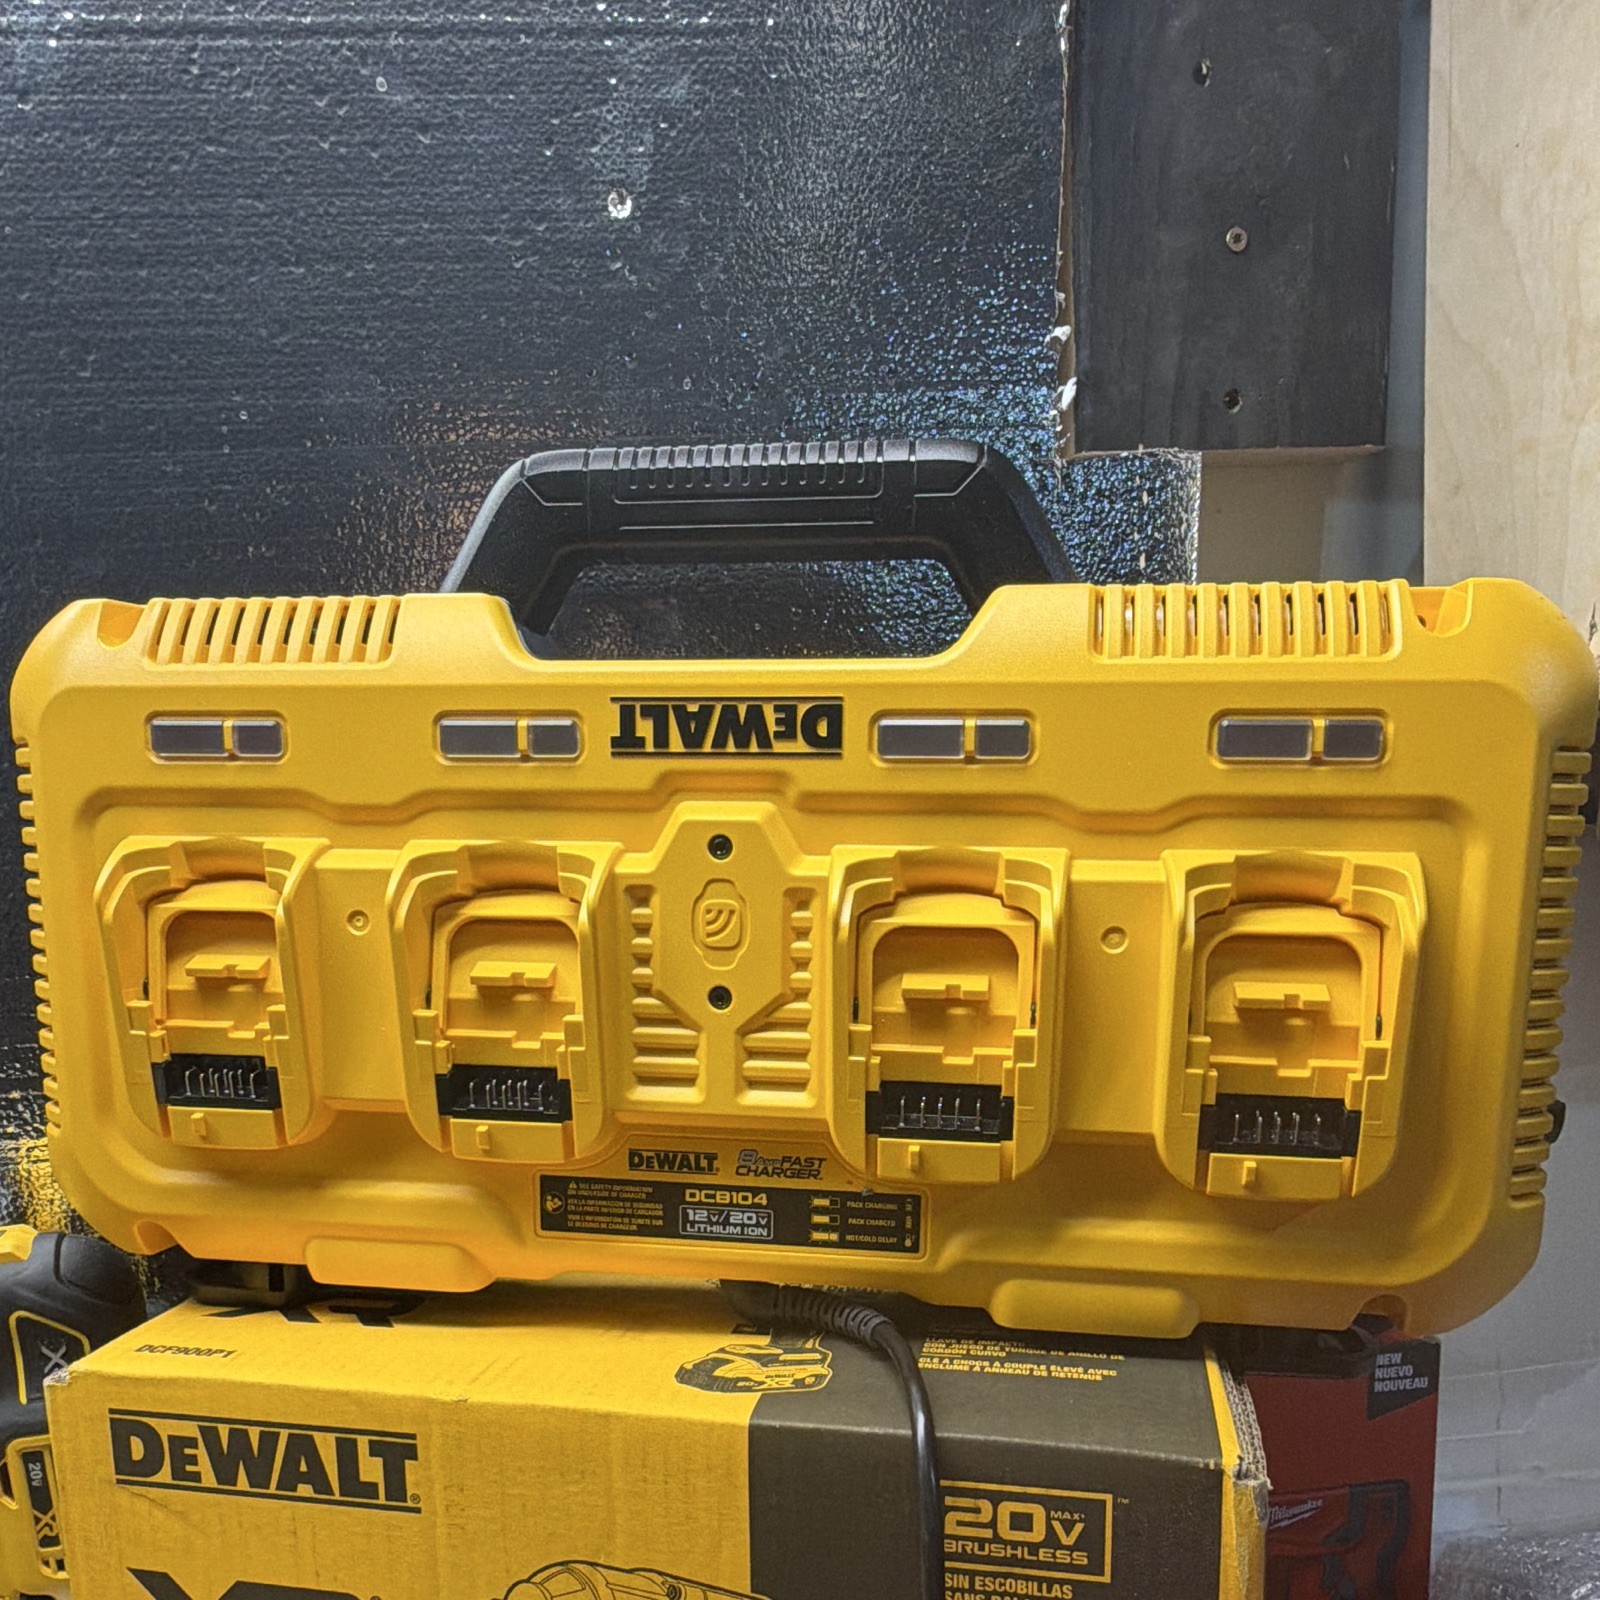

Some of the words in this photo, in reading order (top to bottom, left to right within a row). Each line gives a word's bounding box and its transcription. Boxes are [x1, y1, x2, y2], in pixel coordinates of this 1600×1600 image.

[610, 703, 843, 750] DEWALT
[628, 1151, 719, 1173] DEWALT
[781, 1156, 827, 1169] FAST
[735, 1165, 823, 1181] CHARGER
[685, 1189, 768, 1206] DCB104
[847, 1201, 863, 1209] PACK
[686, 1223, 741, 1235] LITHIUM
[744, 1226, 768, 1236] ION
[848, 1217, 865, 1226] PACK
[134, 1343, 238, 1359] DCF900P1
[1375, 1352, 1403, 1366] NEW
[1374, 1364, 1414, 1380] NUEVO
[1373, 1376, 1429, 1393] NOUVEAU
[109, 1417, 419, 1503] DEWALT
[944, 1538, 1089, 1566] BRUSHLESS
[944, 1572, 970, 1590] SIN
[974, 1575, 1073, 1600] ESCOBILLAS
